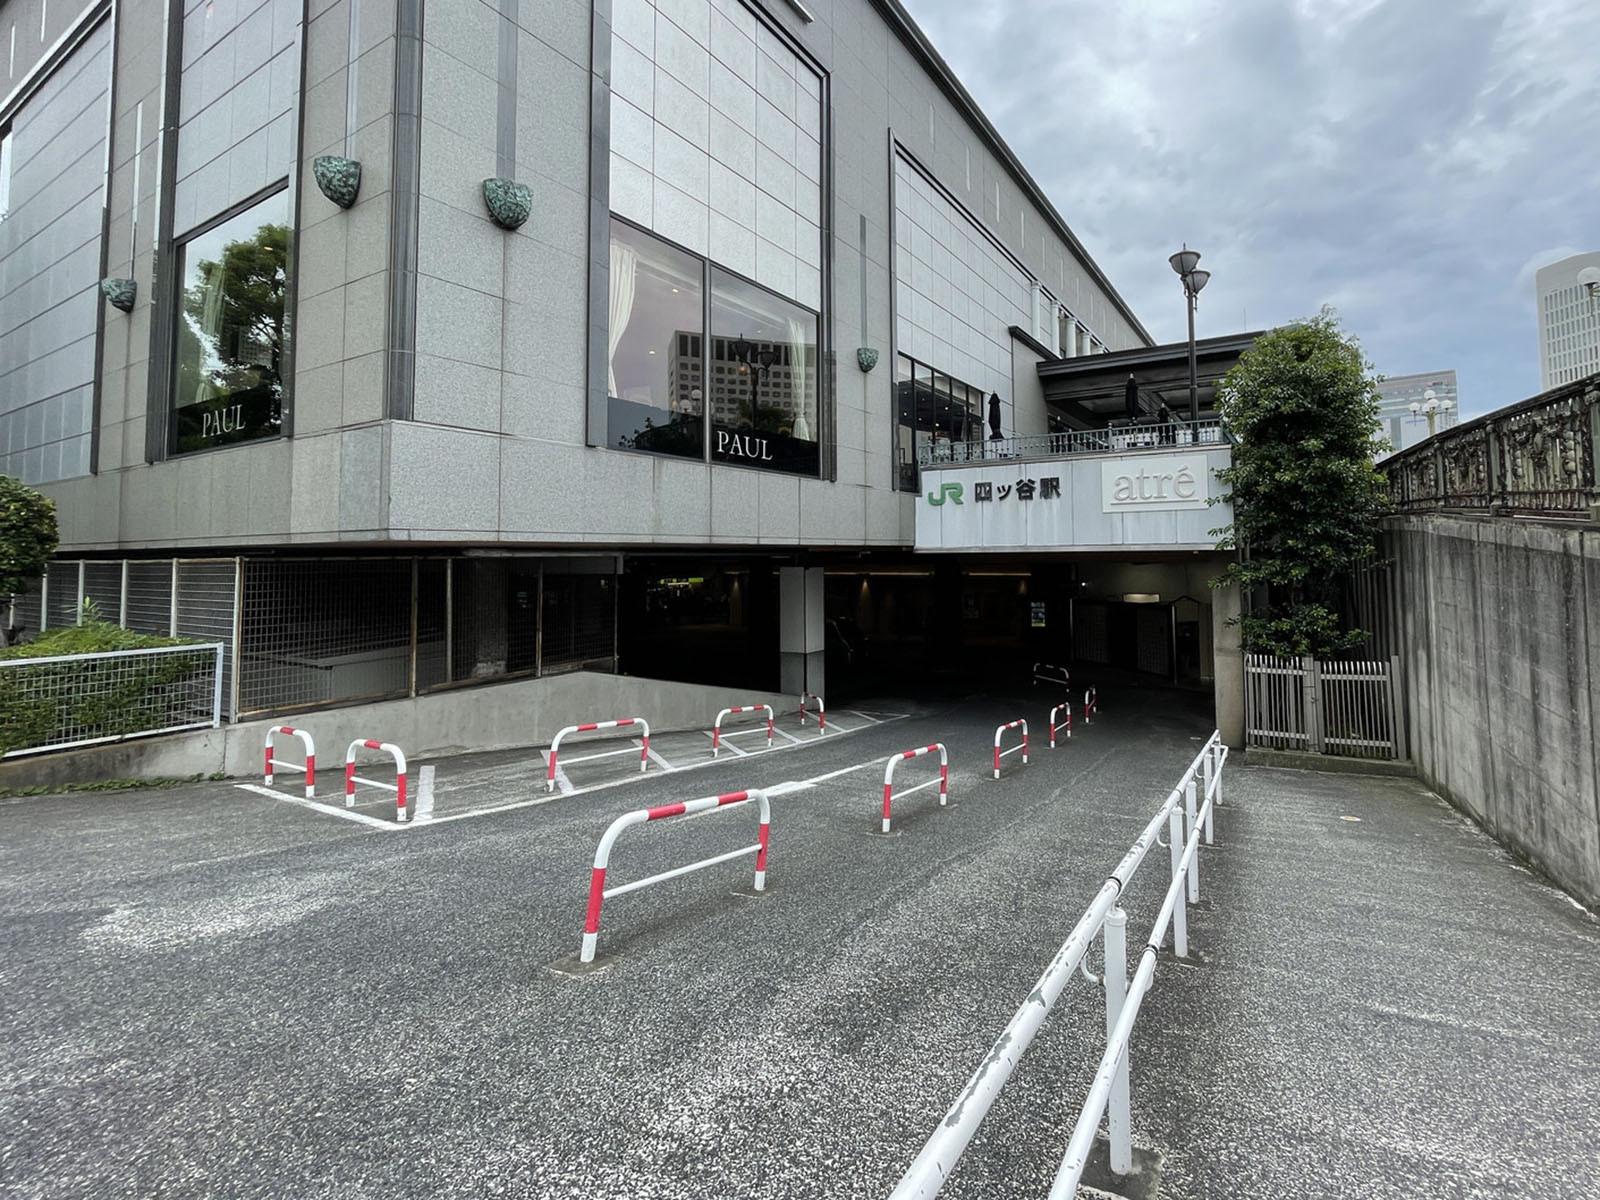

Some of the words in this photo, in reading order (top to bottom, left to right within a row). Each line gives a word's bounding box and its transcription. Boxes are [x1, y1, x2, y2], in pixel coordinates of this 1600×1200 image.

[202, 404, 246, 438] PAUL
[717, 431, 773, 460] PAUL
[928, 483, 964, 506] JR
[974, 477, 1061, 503] 四ツ谷駅
[1114, 465, 1195, 501] atré
